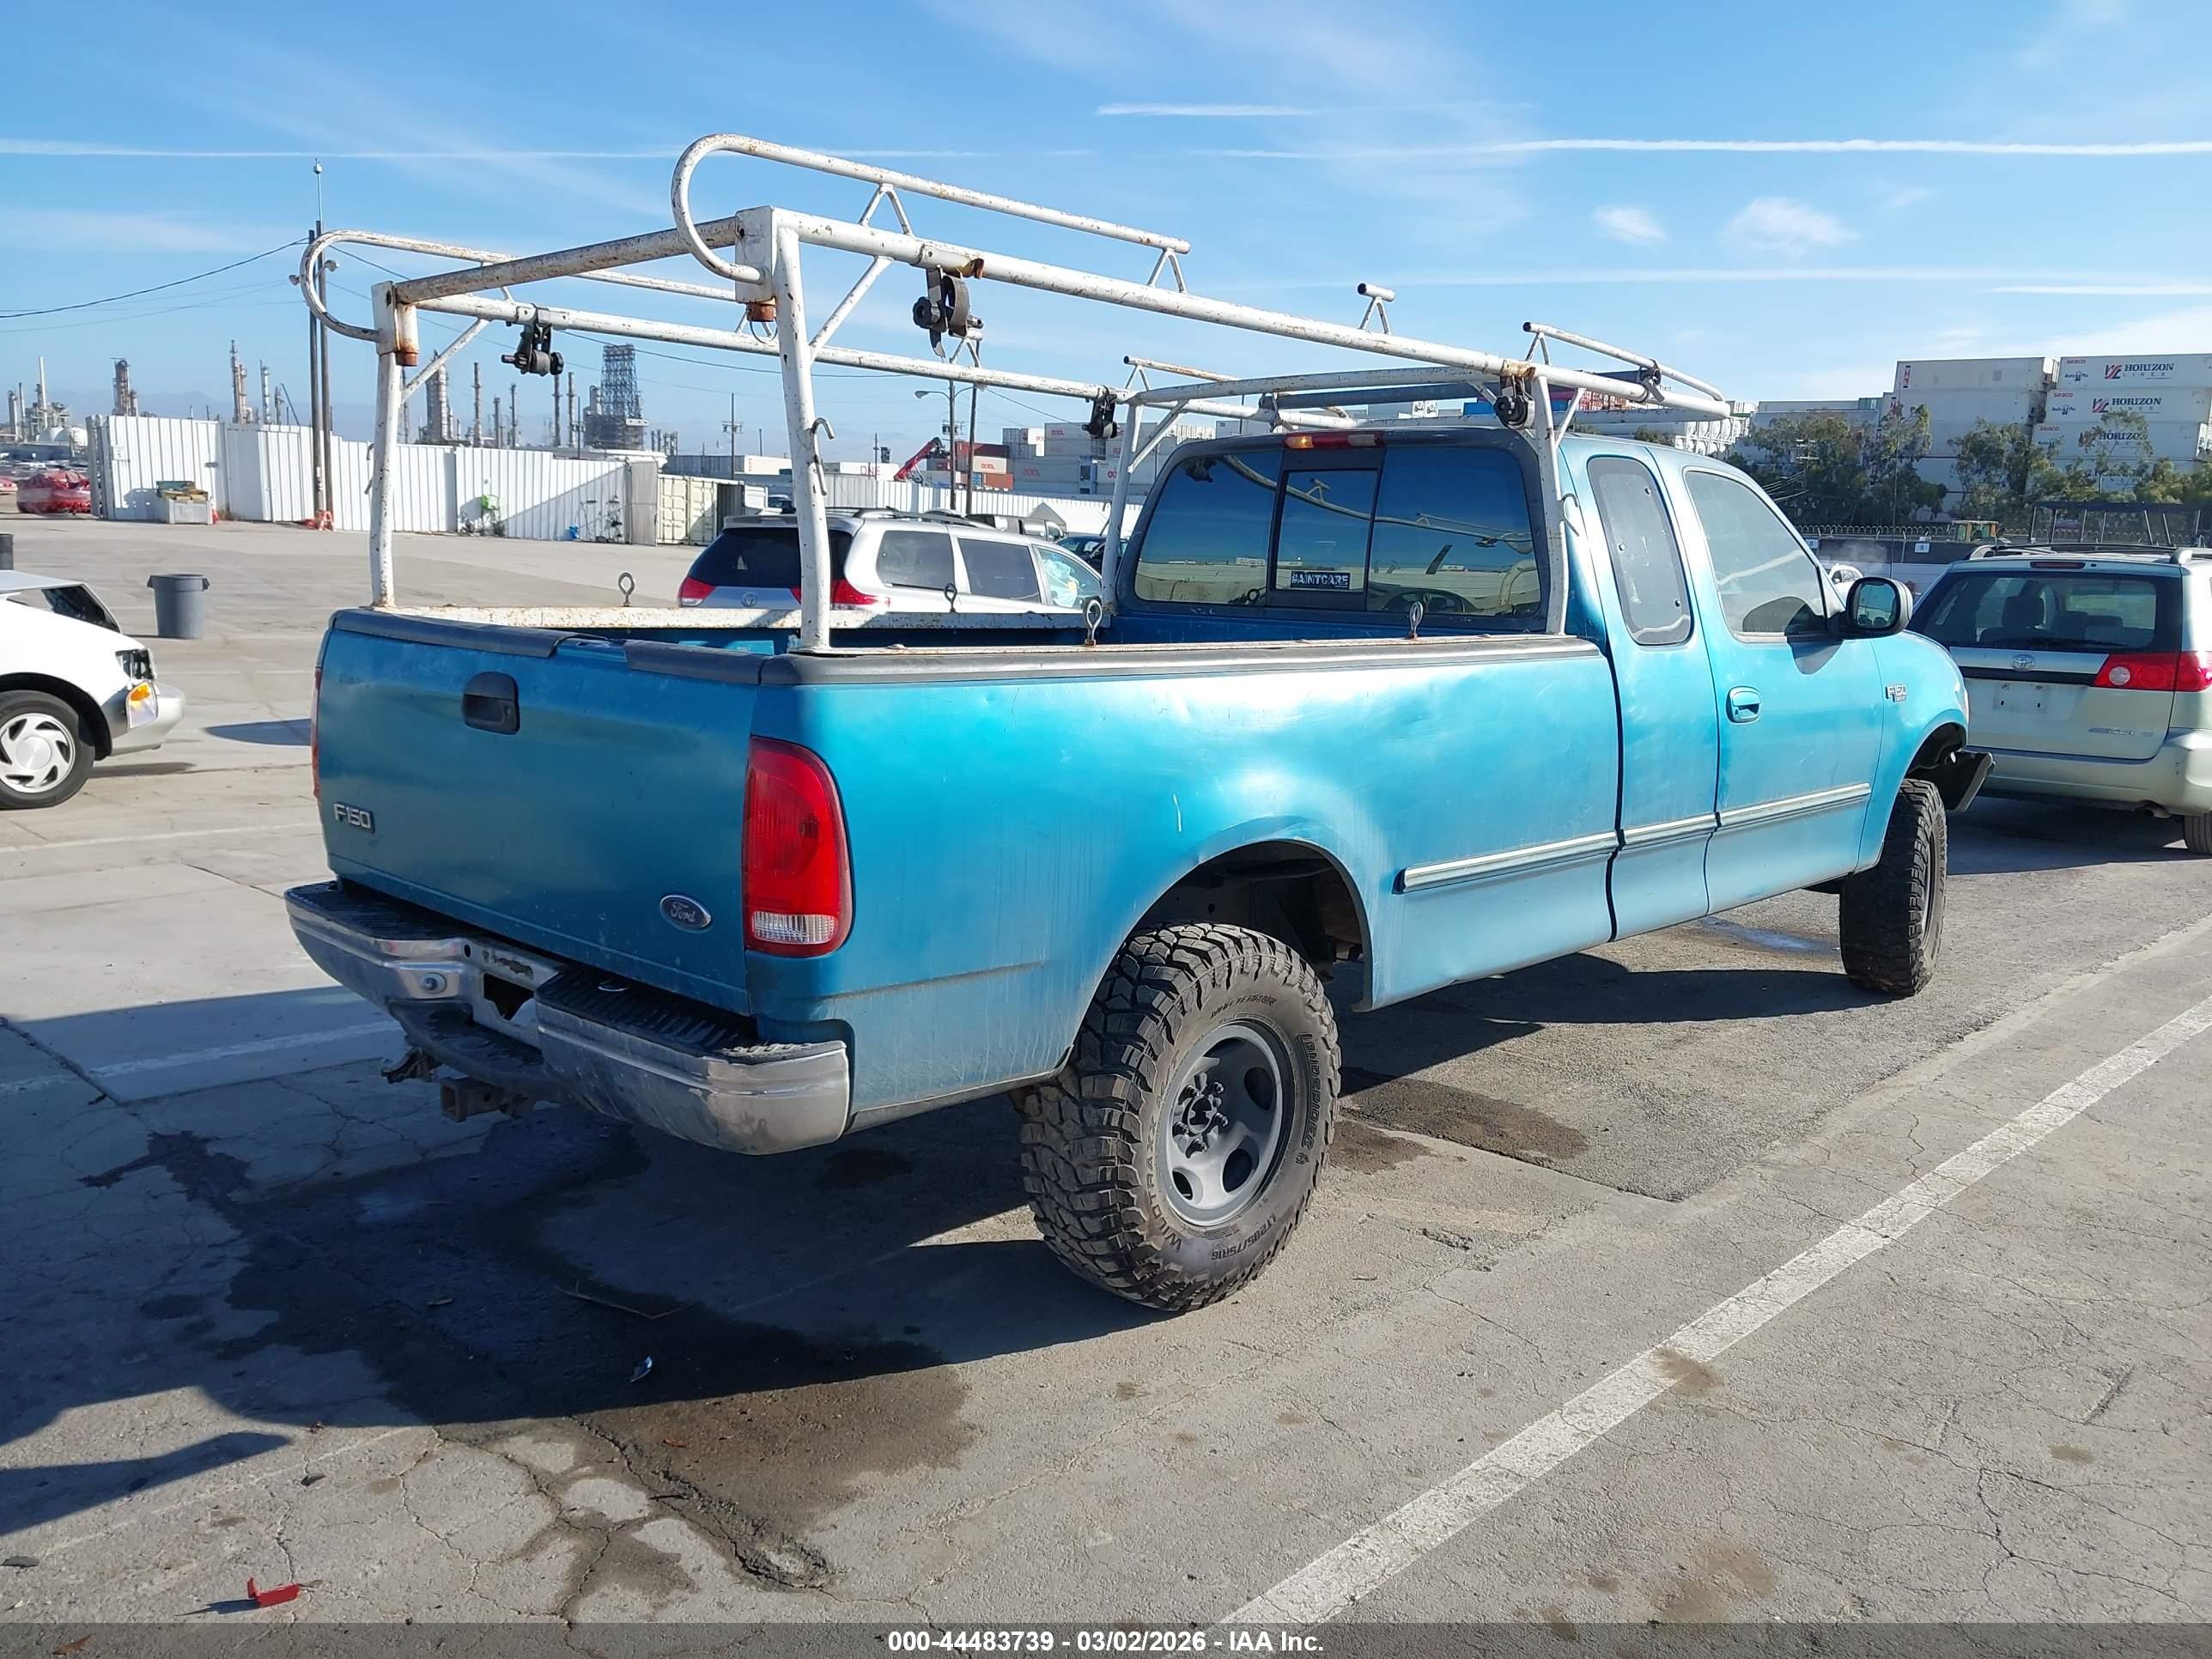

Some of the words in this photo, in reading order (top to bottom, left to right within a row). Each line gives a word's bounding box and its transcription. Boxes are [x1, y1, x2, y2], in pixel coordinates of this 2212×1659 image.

[2124, 363, 2174, 372] HORIZON
[2112, 398, 2161, 406] HORIZON
[334, 803, 372, 830] F150
[1297, 1032, 1322, 1151] LANDSPIDER
